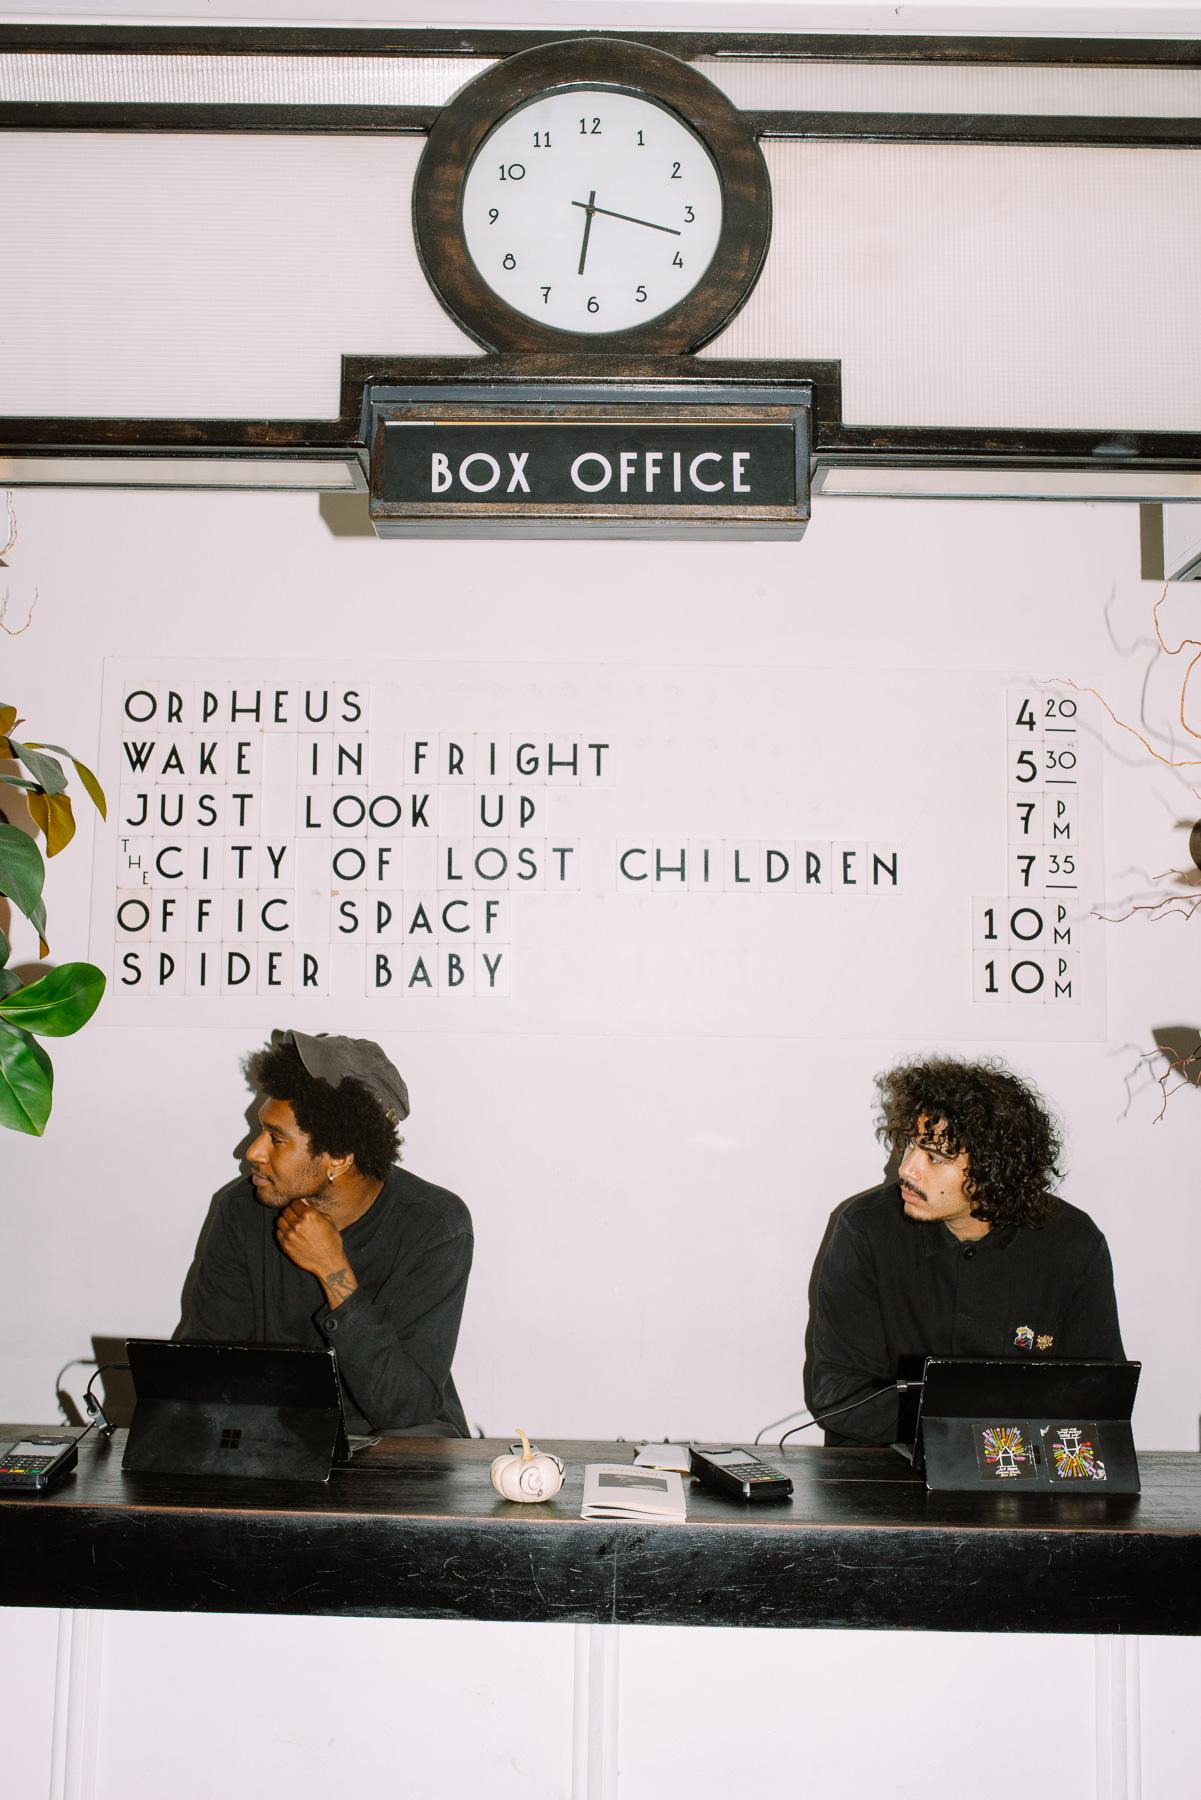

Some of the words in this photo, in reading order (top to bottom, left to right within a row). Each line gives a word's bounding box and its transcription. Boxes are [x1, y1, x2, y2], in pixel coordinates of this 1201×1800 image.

[580, 118, 601, 134] 12
[534, 132, 551, 147] 11
[638, 130, 644, 145] 1
[500, 164, 525, 180] 10
[671, 162, 681, 178] 2
[489, 209, 498, 224] 9
[684, 207, 694, 222] 3
[503, 254, 516, 270] 8
[673, 252, 683, 268] 4
[541, 287, 551, 303] 7
[636, 286, 647, 302] 5
[588, 297, 599, 313] 6
[432, 453, 530, 492] BOX
[571, 452, 750, 492] OFFICE
[125, 691, 361, 722] ORPHEUS
[123, 742, 250, 774] WAKE
[313, 743, 361, 775] IN
[415, 742, 609, 776] FRIGHT
[127, 794, 253, 826] JUST
[306, 795, 429, 827] LOOK
[481, 795, 534, 827] UP
[156, 846, 286, 879] CITY
[333, 848, 391, 880] OF
[448, 848, 573, 880] LOST
[620, 849, 897, 885] CHILDREN
[117, 899, 289, 932] OFFIC
[339, 901, 499, 933] SPACF
[985, 908, 1043, 940] 10
[122, 952, 318, 986] SPIDER
[376, 954, 502, 987] BABY
[986, 961, 1044, 993] 10
